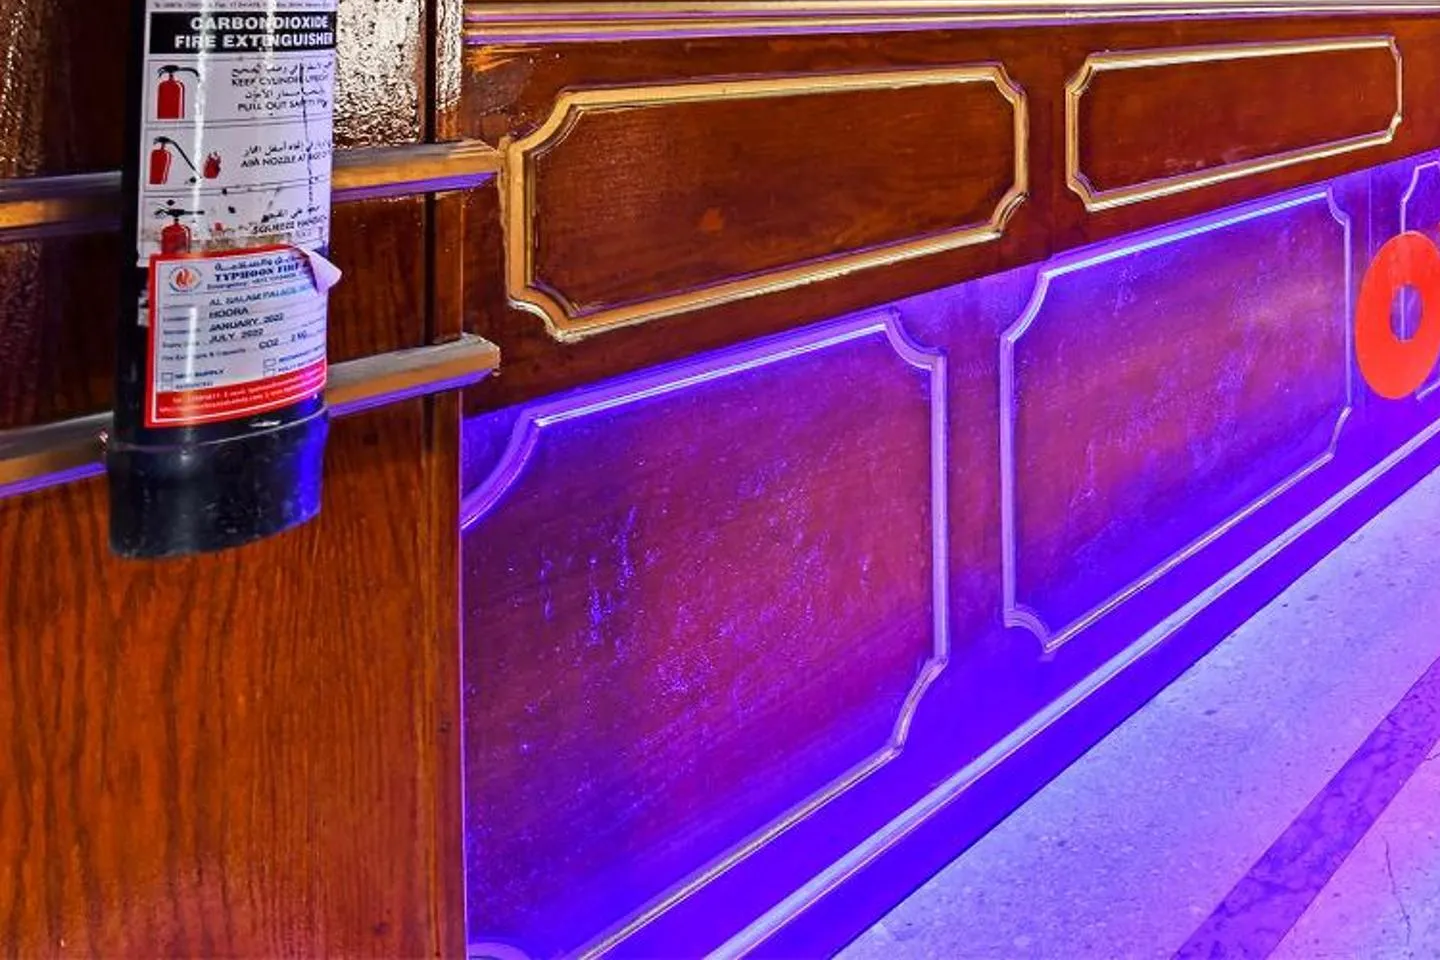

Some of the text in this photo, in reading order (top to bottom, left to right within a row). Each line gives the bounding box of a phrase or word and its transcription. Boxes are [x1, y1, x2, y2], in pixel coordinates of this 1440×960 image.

[174, 32, 333, 49] FIRE EXTINGUISHER
[237, 102, 261, 112] PULL
[214, 268, 274, 282] TYPHOON
[209, 307, 249, 319] HOORA
[259, 338, 279, 349] CO2
